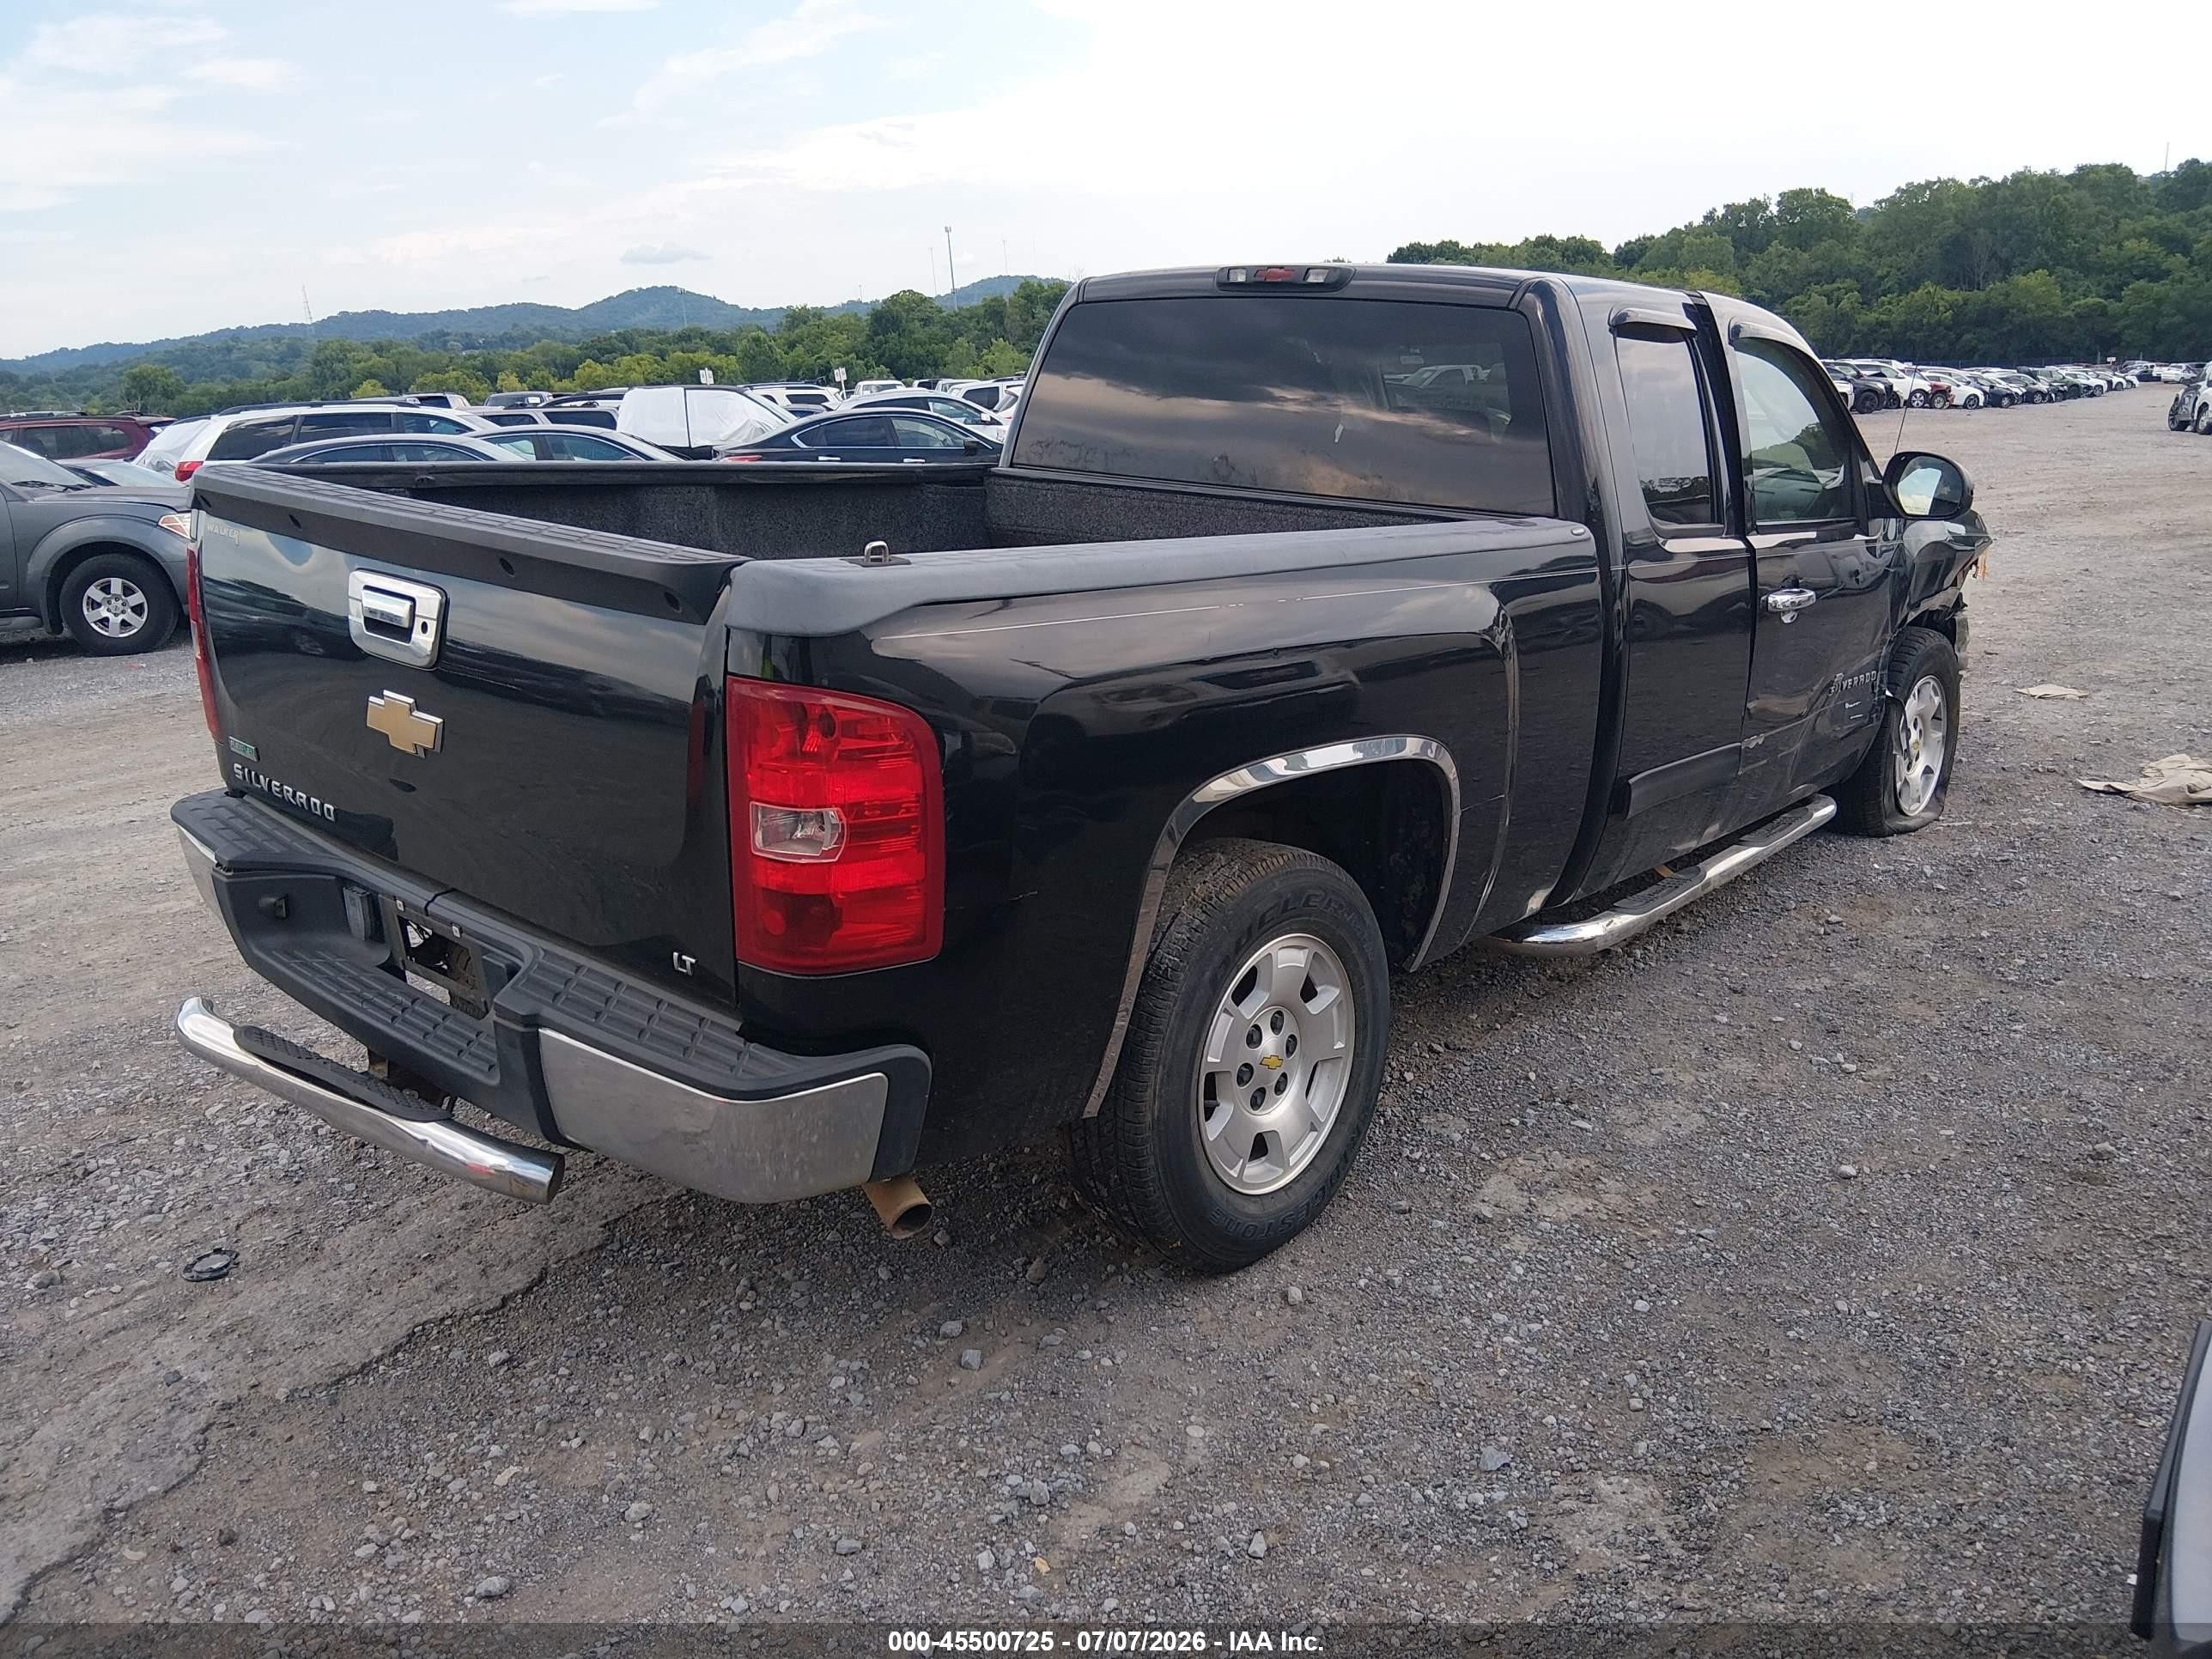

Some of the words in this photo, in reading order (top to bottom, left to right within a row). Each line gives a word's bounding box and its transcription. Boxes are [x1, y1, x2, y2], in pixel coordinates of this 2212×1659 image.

[207, 521, 240, 545] WALKER
[234, 763, 336, 823] SILVERADO
[673, 951, 696, 976] LT
